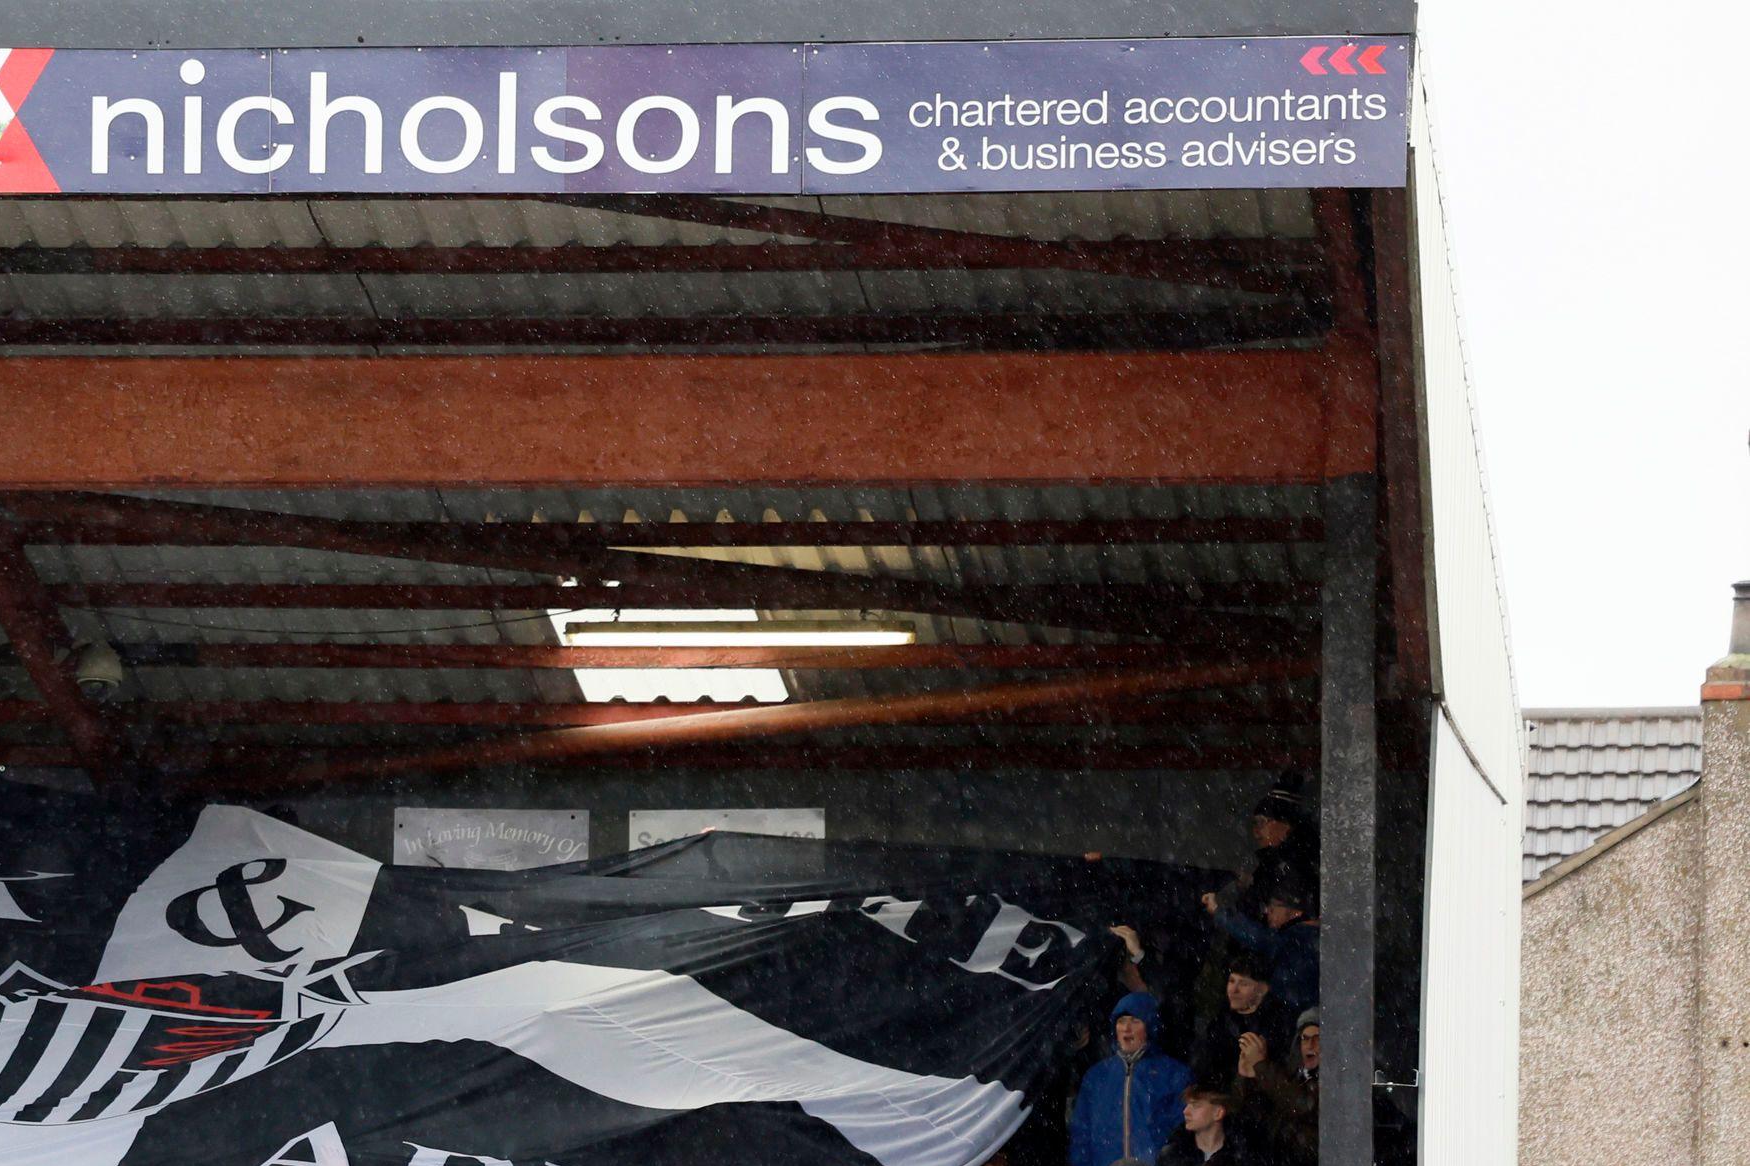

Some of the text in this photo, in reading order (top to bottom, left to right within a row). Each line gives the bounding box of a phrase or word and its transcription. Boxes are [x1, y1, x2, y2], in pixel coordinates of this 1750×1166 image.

[91, 59, 883, 176] nicholsons
[908, 88, 1387, 128] chartered accountants
[937, 132, 1357, 171] & business advisers
[403, 821, 588, 865] In Loving Memory Of
[165, 858, 316, 963] &
